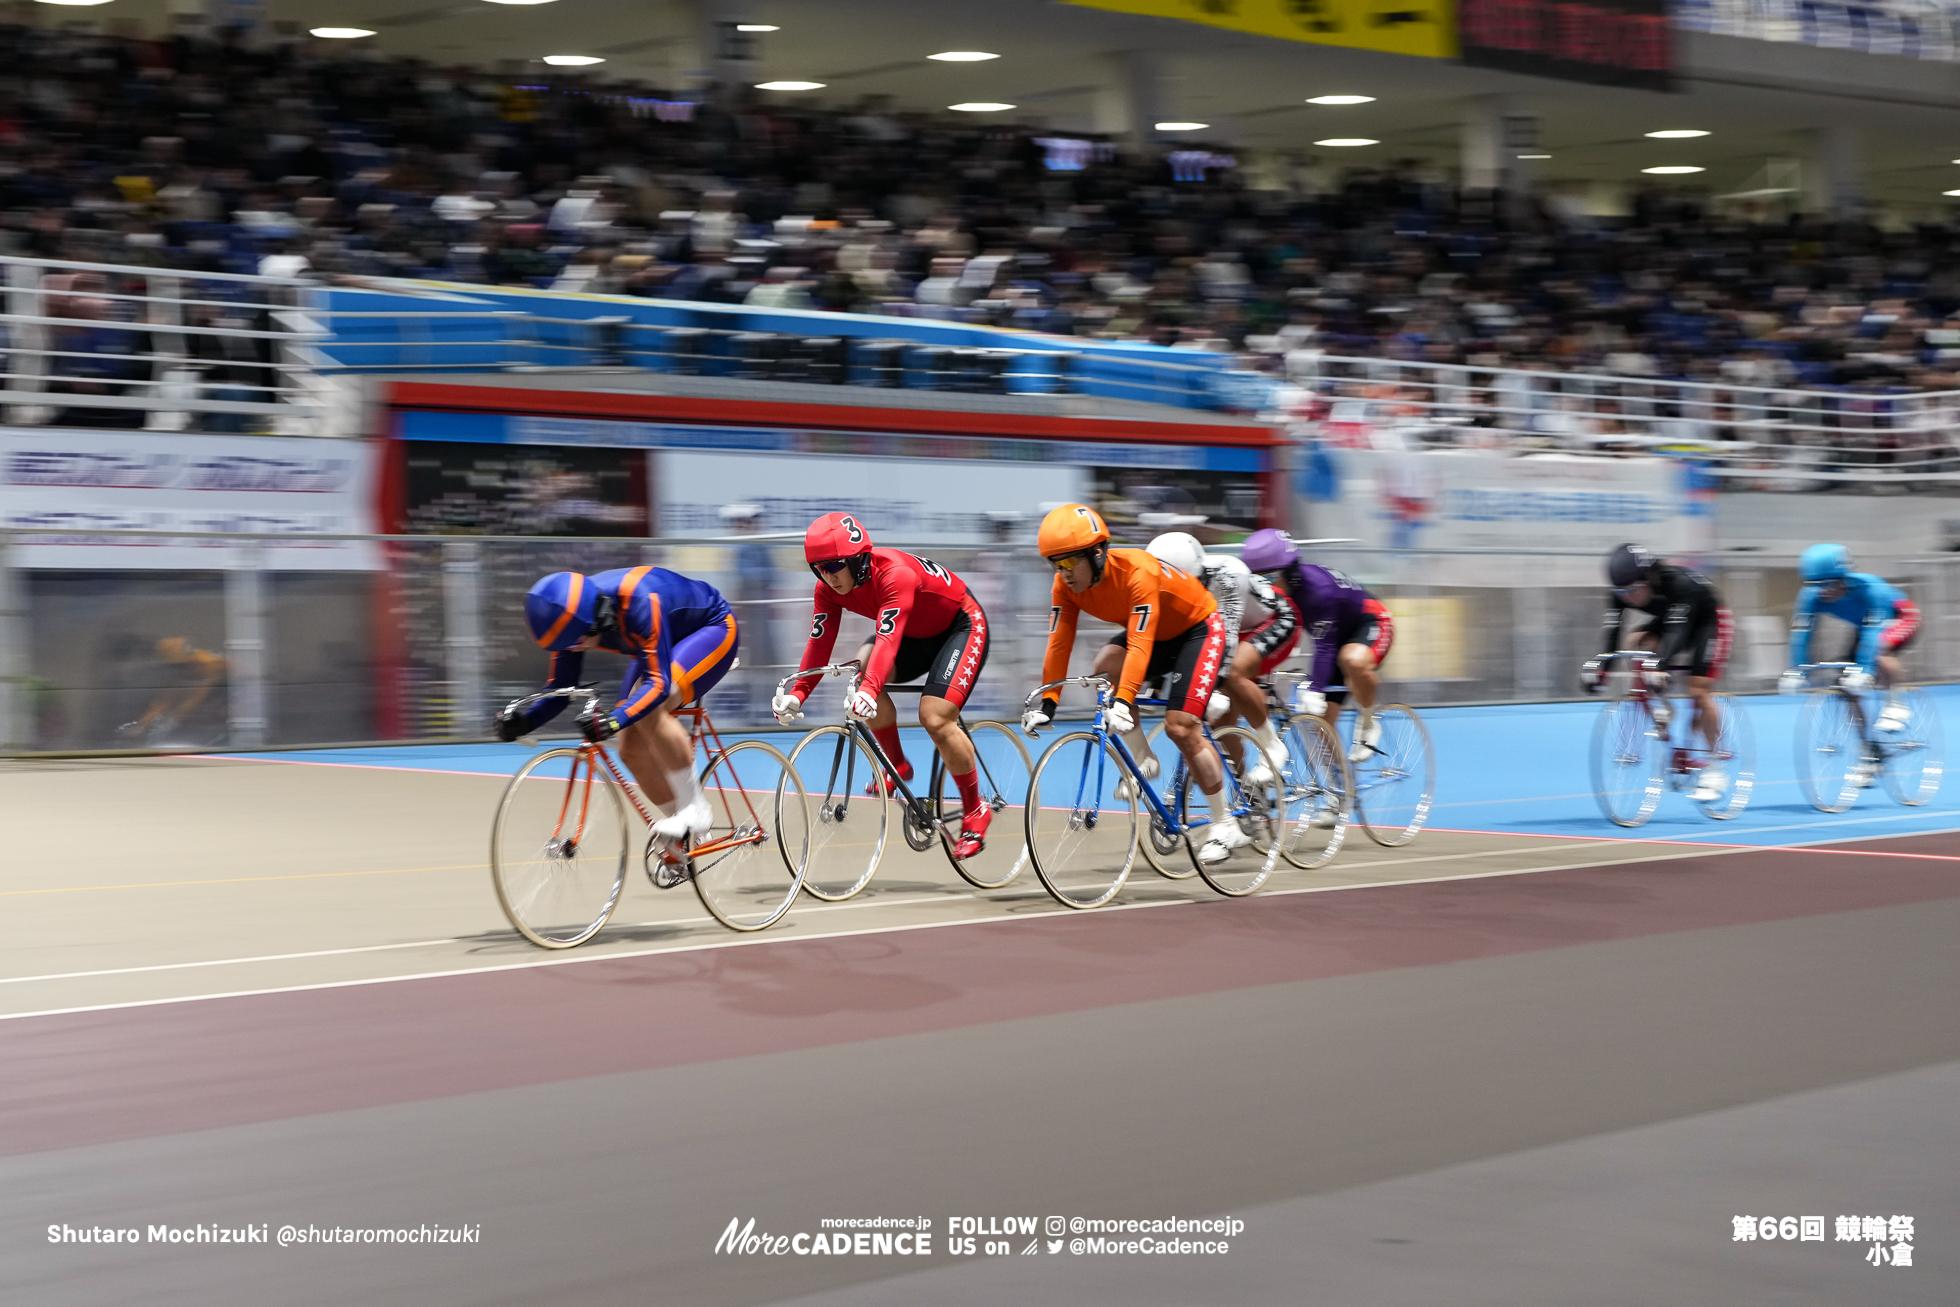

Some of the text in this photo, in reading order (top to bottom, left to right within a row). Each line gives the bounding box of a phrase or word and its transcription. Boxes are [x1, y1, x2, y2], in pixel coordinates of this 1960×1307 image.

[840, 516, 863, 543] 3
[1074, 507, 1101, 534] 7
[810, 613, 828, 638] 3
[878, 608, 900, 635] 3
[1050, 606, 1062, 633] 7
[1132, 604, 1151, 632] 7
